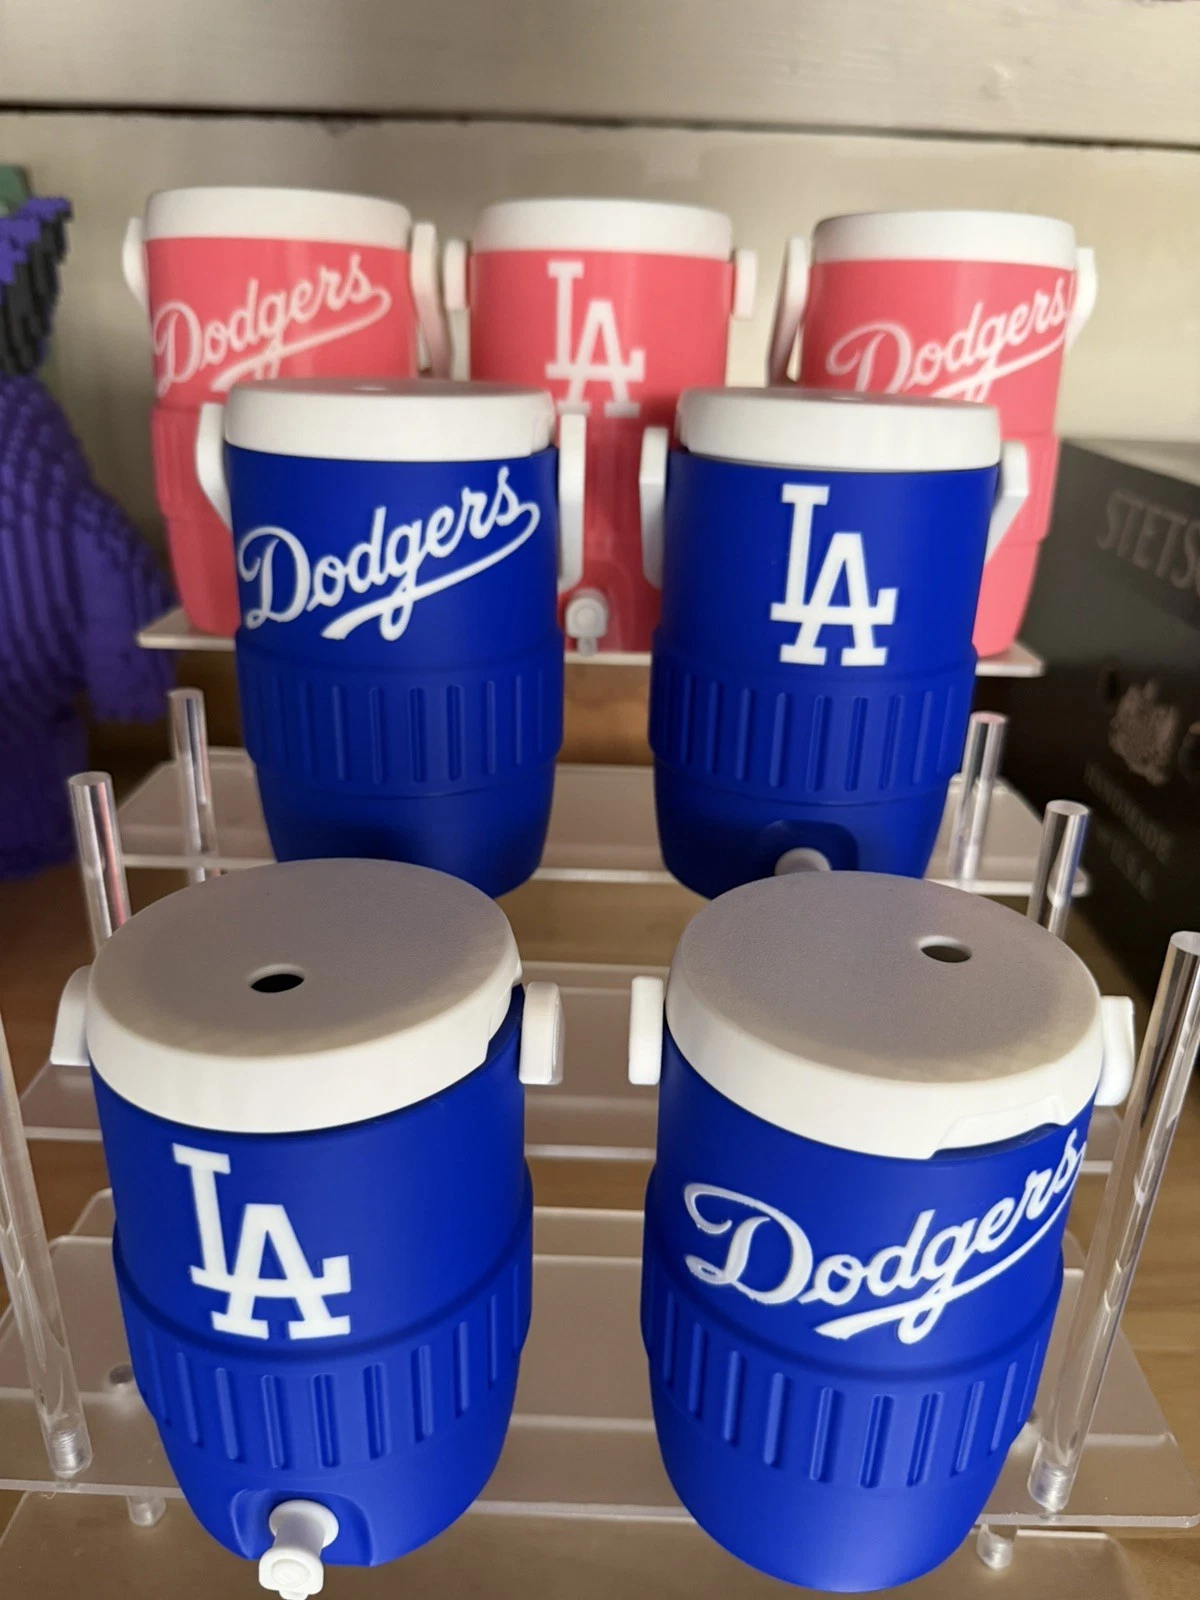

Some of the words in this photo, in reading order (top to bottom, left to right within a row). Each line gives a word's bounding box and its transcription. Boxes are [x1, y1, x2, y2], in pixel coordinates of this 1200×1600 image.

[152, 252, 392, 396] Dodgers
[545, 260, 645, 418] LA
[825, 276, 1071, 402] Dodgers
[238, 466, 541, 640] Dodgers
[770, 483, 897, 667] LA
[1096, 488, 1200, 597] STETS
[172, 1143, 351, 1340] LA
[684, 1128, 1087, 1344] Dodgers
